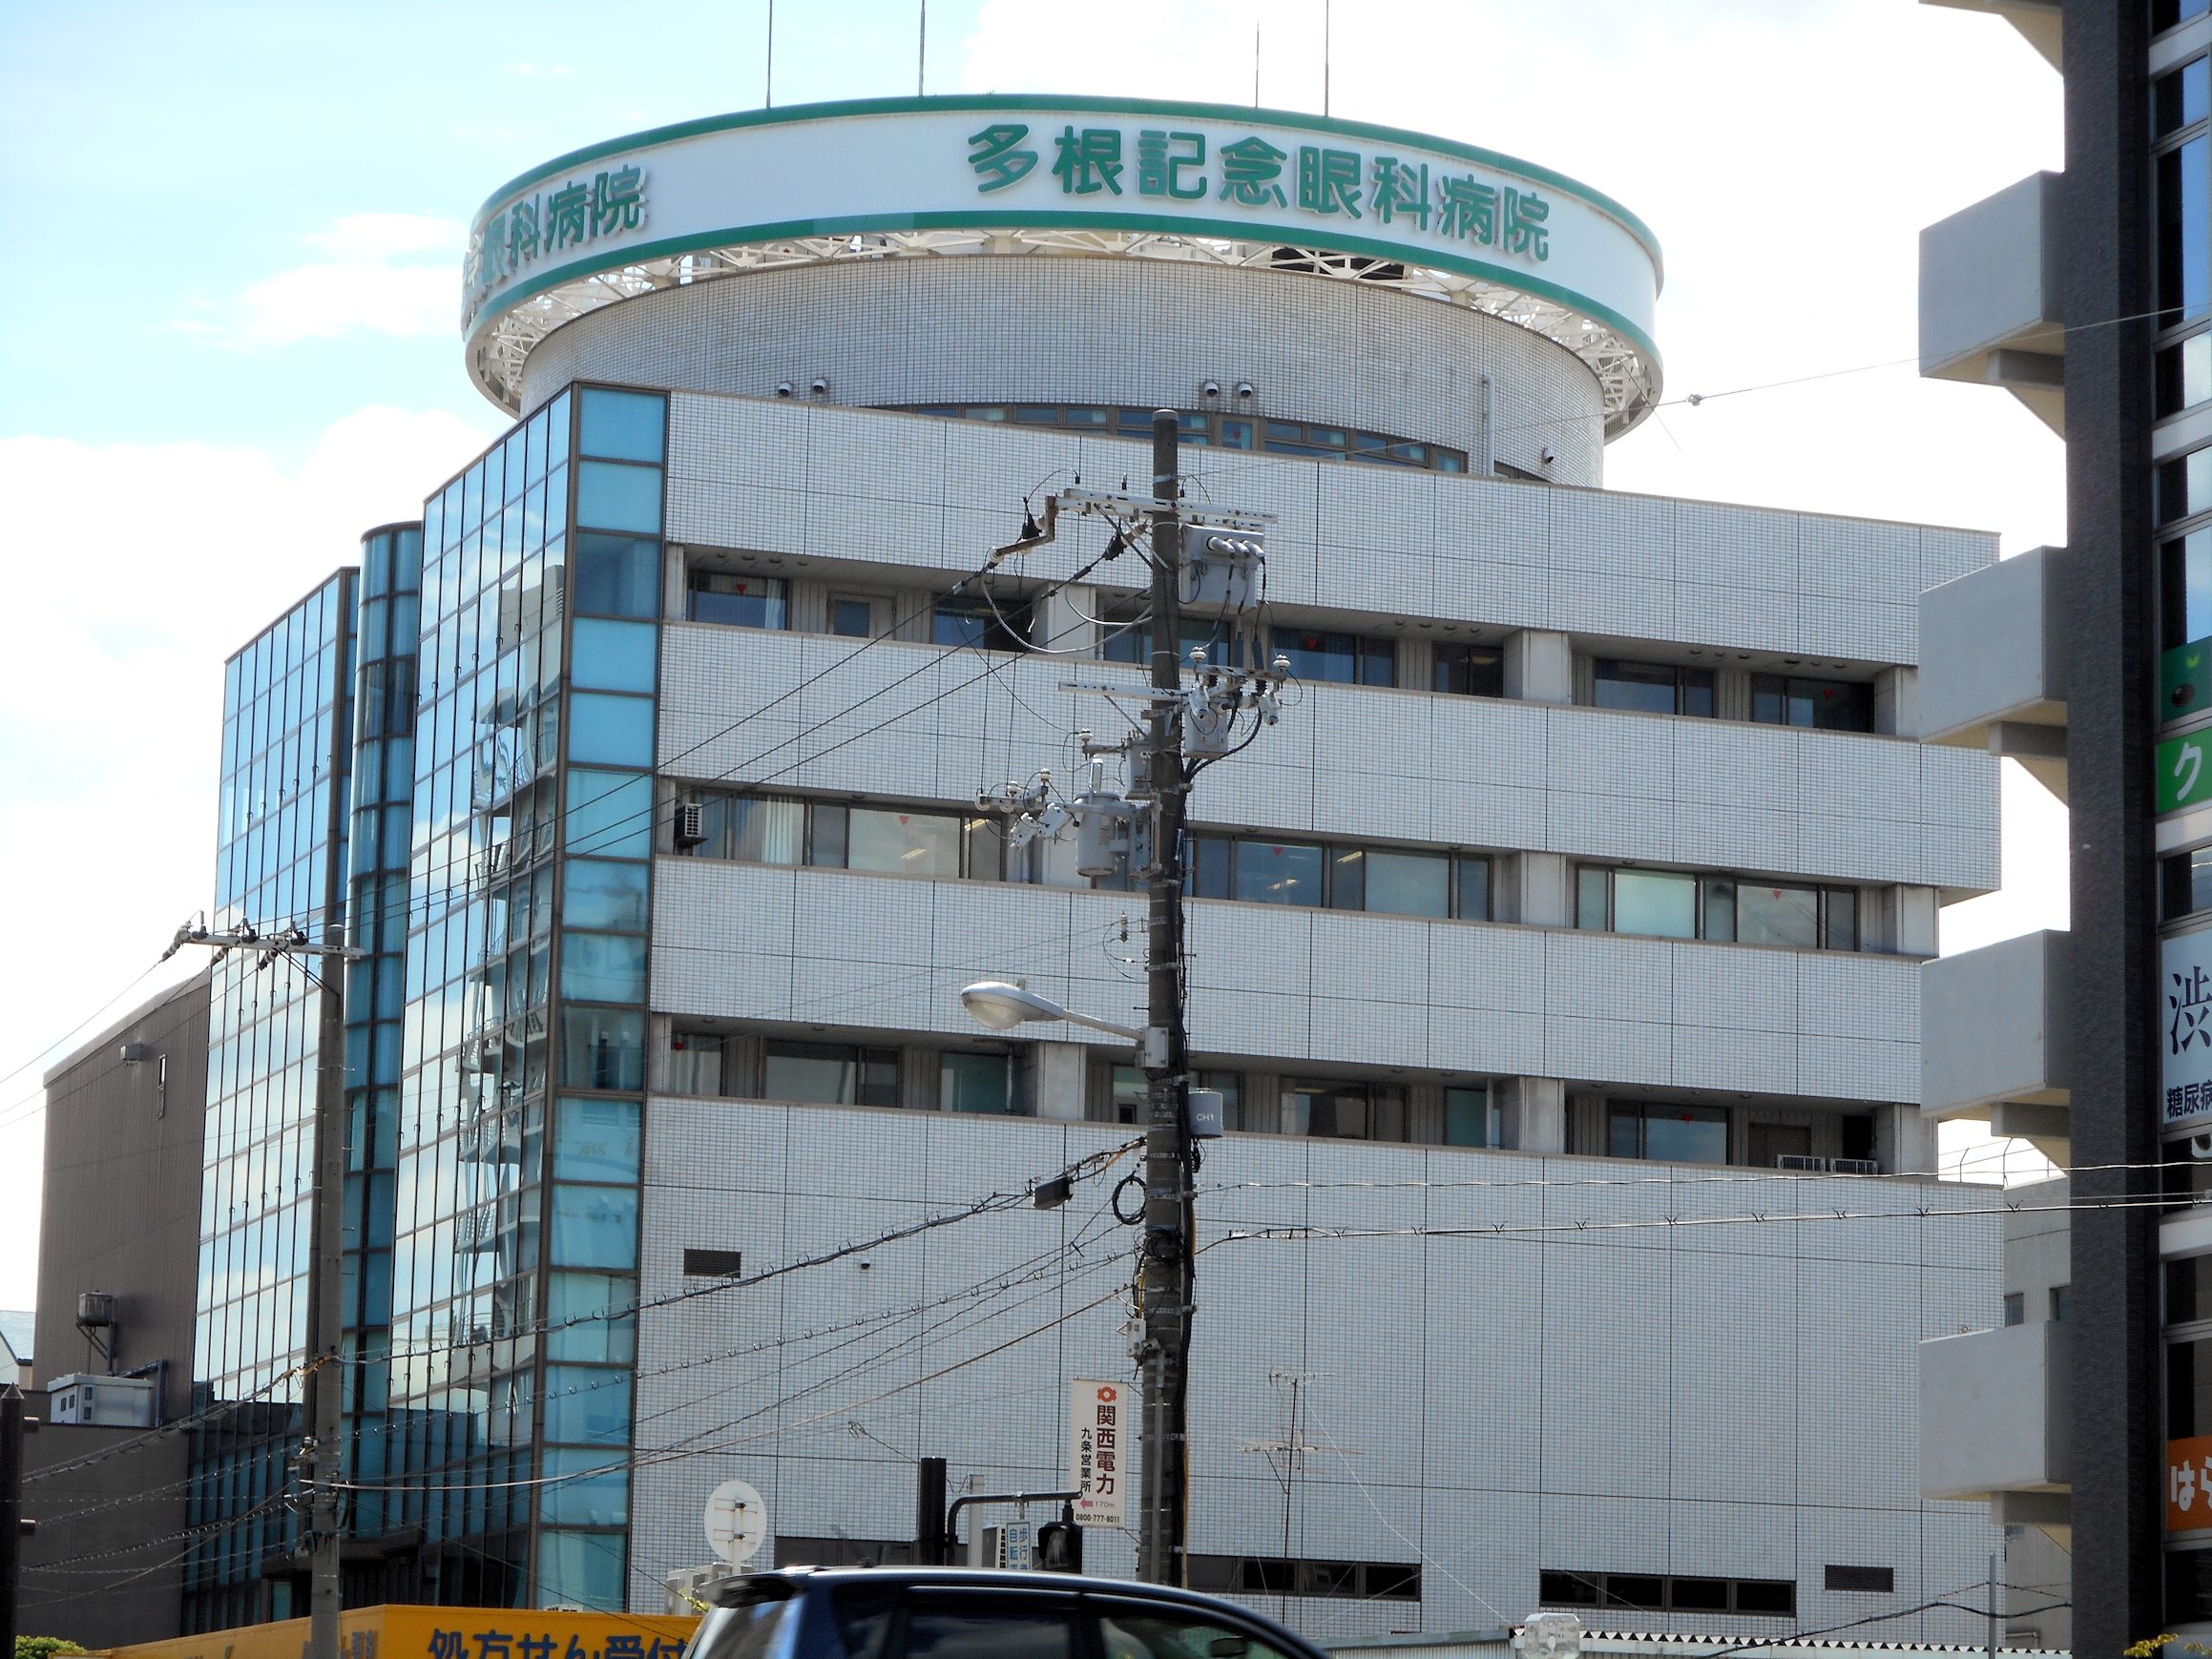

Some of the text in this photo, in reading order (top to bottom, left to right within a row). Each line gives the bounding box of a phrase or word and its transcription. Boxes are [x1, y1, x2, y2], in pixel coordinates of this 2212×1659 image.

[468, 164, 643, 288] 眼科病院
[968, 123, 1550, 262] 多根記念眼科病院
[2169, 965, 2212, 1055] 渋
[1196, 1112, 1214, 1122] CH1
[1080, 1427, 1093, 1493] 九条営業所
[1096, 1404, 1116, 1496] 関西電力
